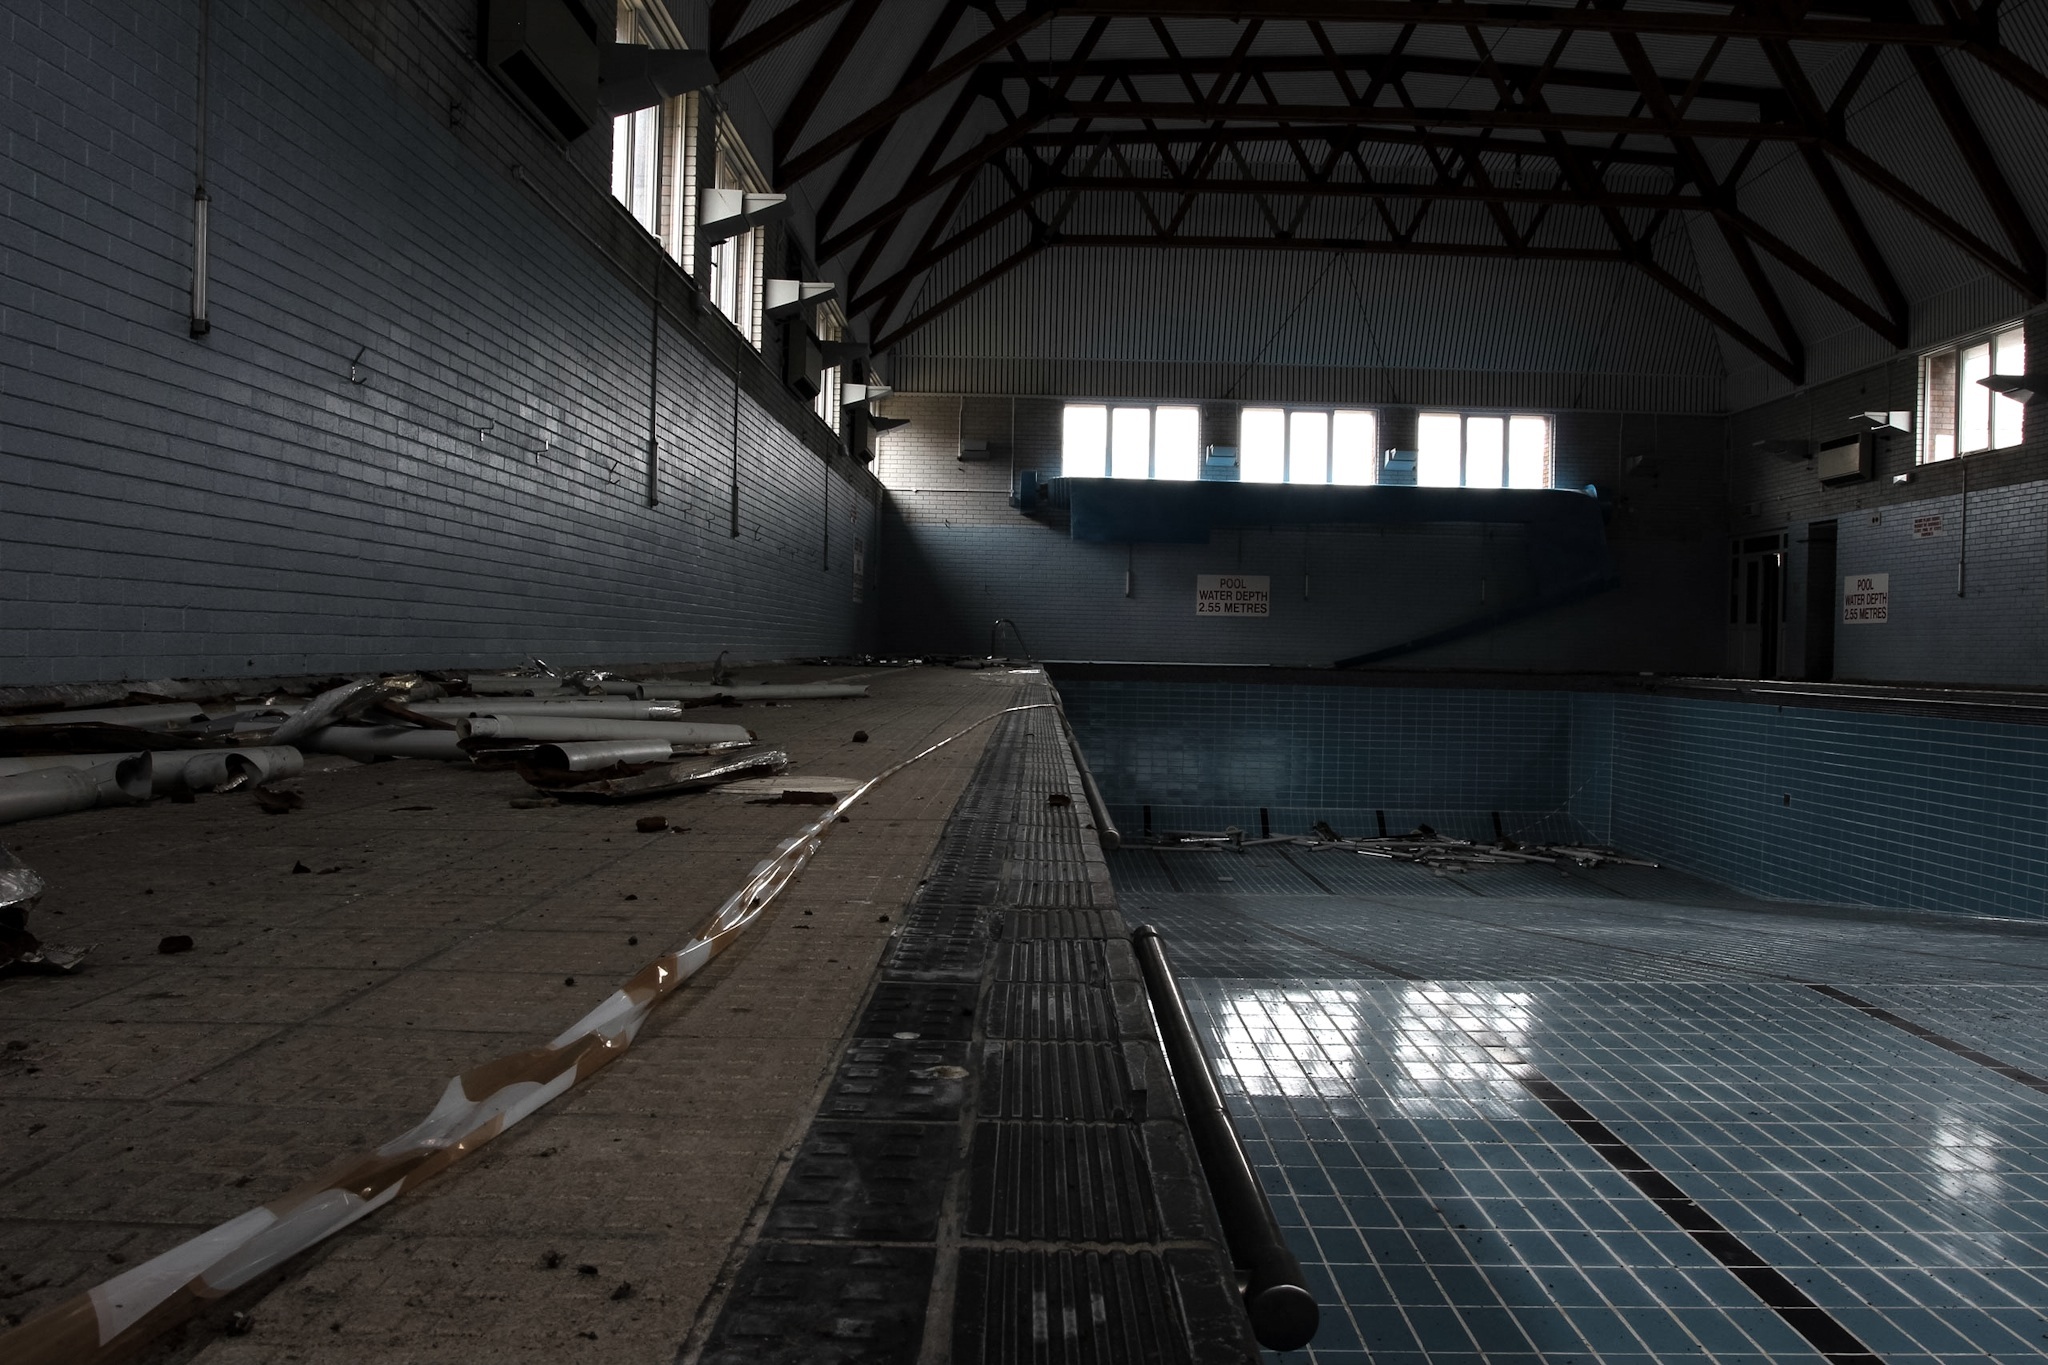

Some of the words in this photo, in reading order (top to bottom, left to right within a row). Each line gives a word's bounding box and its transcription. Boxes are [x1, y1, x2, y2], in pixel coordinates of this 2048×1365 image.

[1220, 578, 1247, 589] POOL
[1857, 578, 1874, 591] POOL
[1199, 590, 1233, 601] WATER
[1235, 591, 1268, 602] DEPTH
[1845, 593, 1865, 606] WATER
[1866, 592, 1888, 605] DEPTH
[1198, 602, 1221, 613] 2.55
[1224, 602, 1267, 614] METRES
[1859, 606, 1887, 620] METRES
